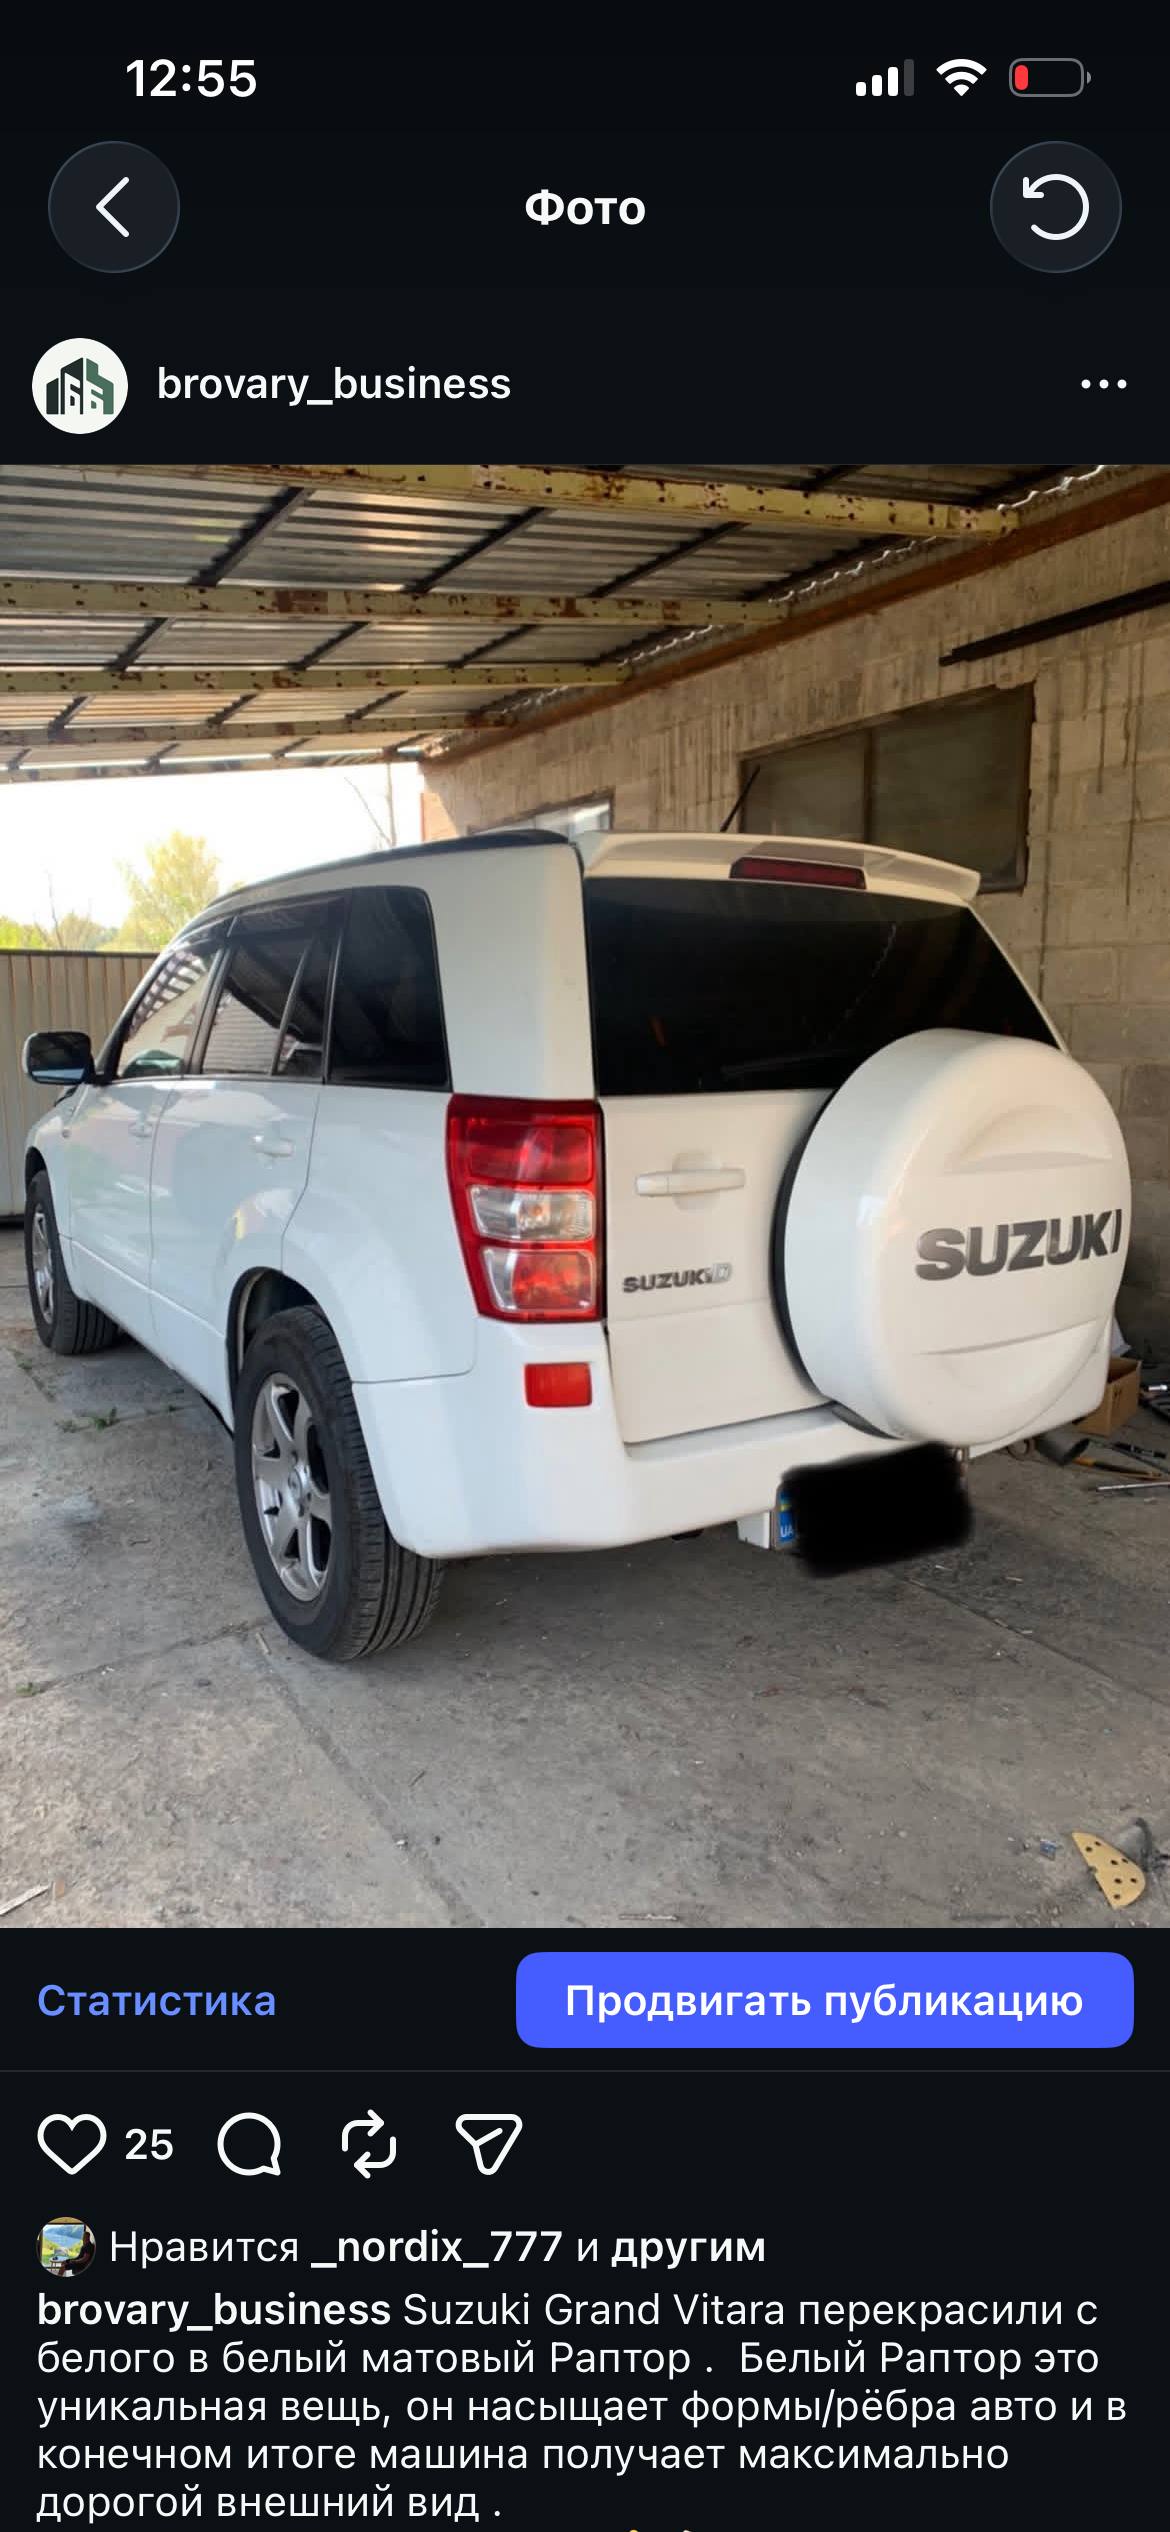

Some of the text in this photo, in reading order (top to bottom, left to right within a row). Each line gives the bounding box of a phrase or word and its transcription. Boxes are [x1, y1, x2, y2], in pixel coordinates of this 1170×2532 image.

[126, 58, 257, 98] 12:55
[525, 188, 646, 226] Фото
[158, 365, 511, 407] brovary_business
[916, 1209, 1122, 1281] SUZUKI
[37, 1983, 276, 2017] Статистика
[567, 1983, 1083, 2024] Продвигать публикацию
[125, 2127, 174, 2161] 25
[111, 2228, 765, 2270] Нравится _nordix_777 и другим
[38, 2291, 1098, 2333] brovary_business Suzuki Grand Vitara перекрасили с
[37, 2339, 175, 2374] белого
[189, 2349, 209, 2373] в
[222, 2339, 346, 2374] белый
[362, 2339, 534, 2374] матовый
[551, 2341, 691, 2381] Раптор
[741, 2339, 865, 2374] Белый
[881, 2341, 1022, 2381] Раптор
[1034, 2348, 1099, 2374] это
[37, 2387, 1127, 2429] уникальная вещь, он насыщает формы/рёбра авто и в
[38, 2444, 1009, 2477] конечном итоге машина получает максимально
[35, 2483, 202, 2525] дорогой
[217, 2483, 393, 2518] внешний
[408, 2493, 480, 2523] вид
